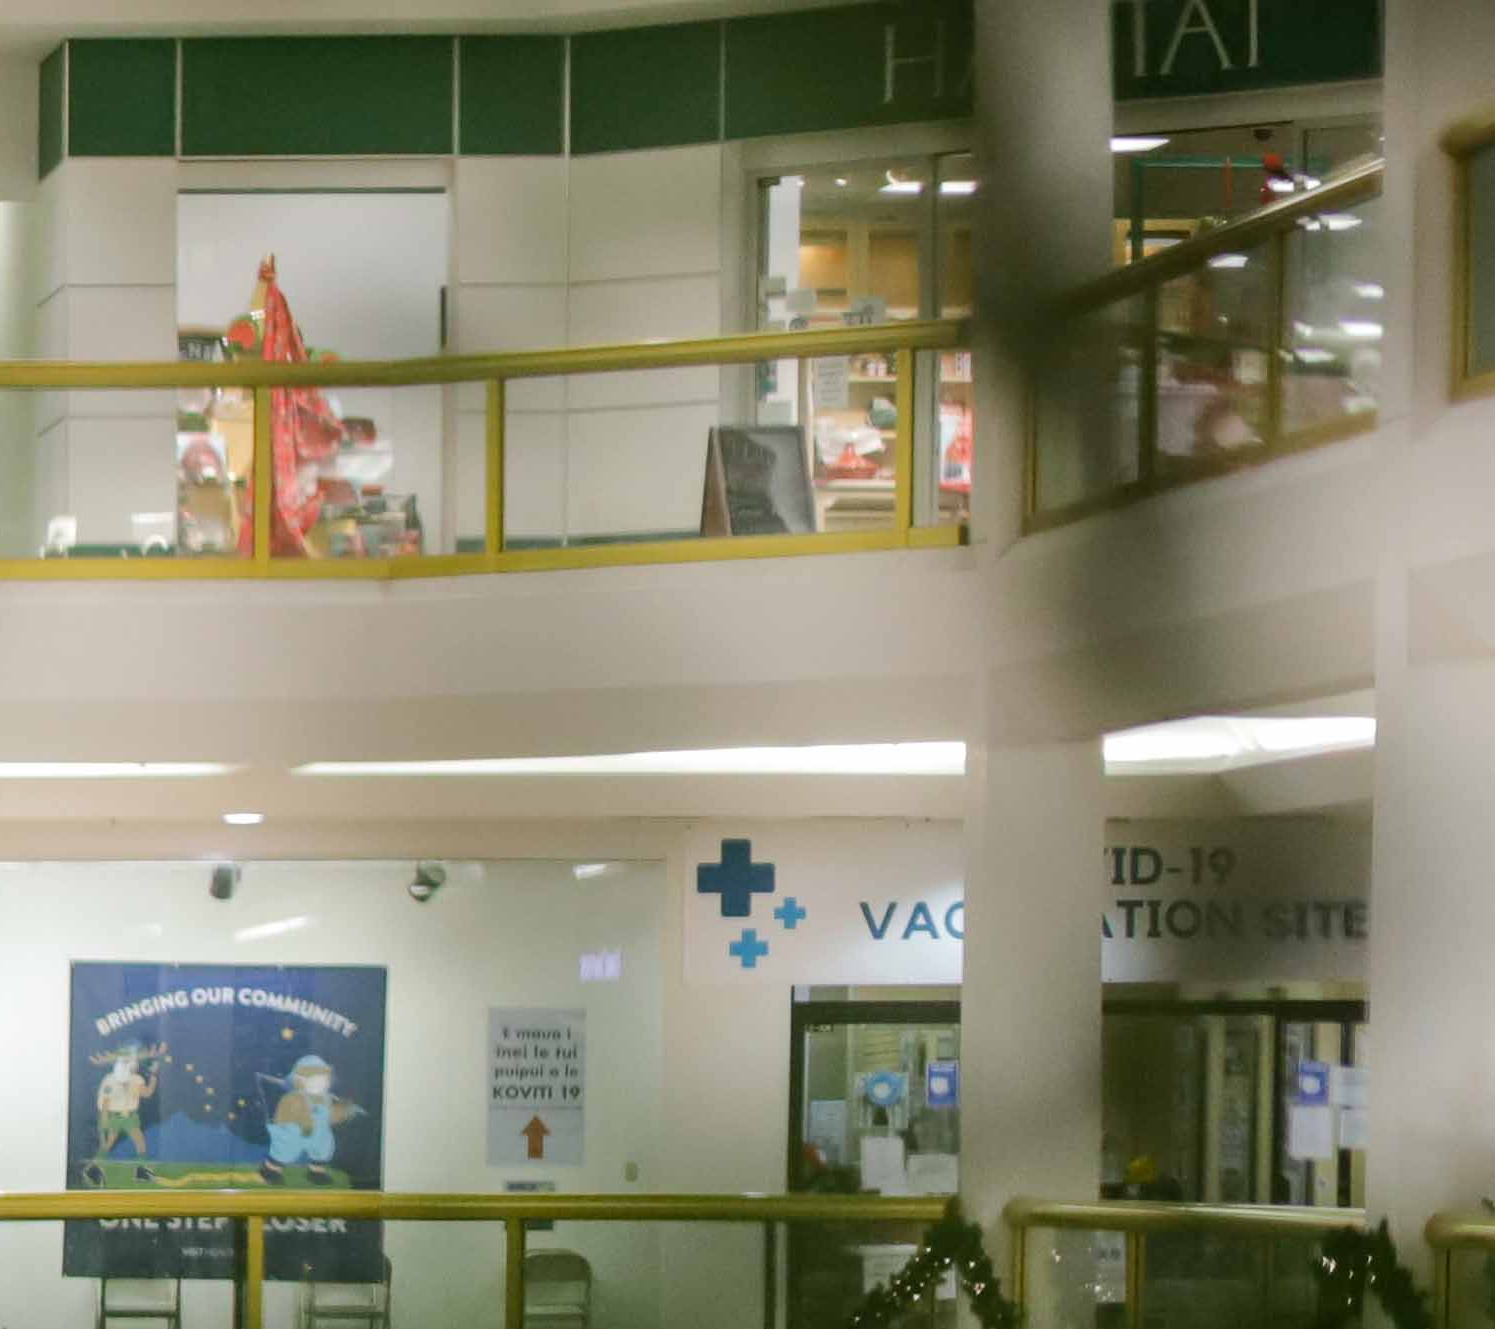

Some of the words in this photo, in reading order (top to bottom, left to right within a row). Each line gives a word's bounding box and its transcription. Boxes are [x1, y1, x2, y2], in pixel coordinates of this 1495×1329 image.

[1261, 901, 1369, 940] SITE
[95, 990, 190, 1036] BRINGING
[191, 987, 236, 1006] OUR
[237, 987, 358, 1038] COMMUNITY
[493, 1086, 553, 1099] KOVITI
[562, 1086, 580, 1099] 19
